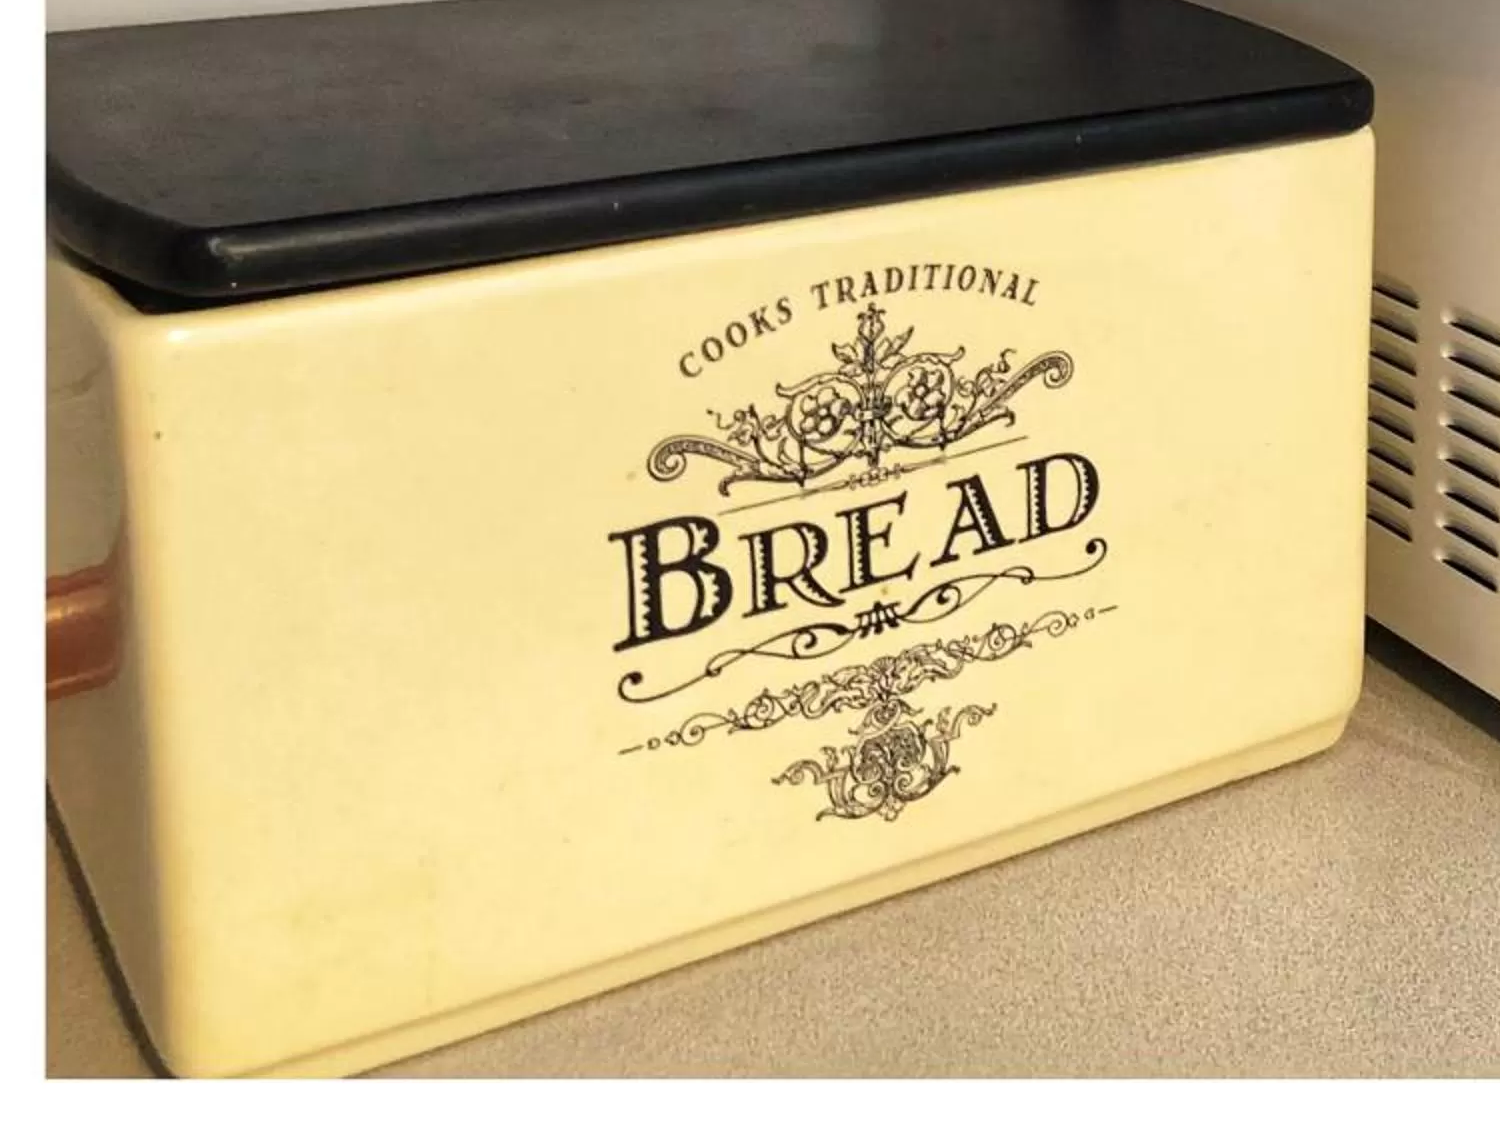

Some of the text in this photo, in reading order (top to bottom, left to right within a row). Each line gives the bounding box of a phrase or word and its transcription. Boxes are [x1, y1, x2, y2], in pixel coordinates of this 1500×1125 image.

[678, 262, 1041, 378] COOKS TRADITIONAL
[607, 451, 1101, 652] BREAD
